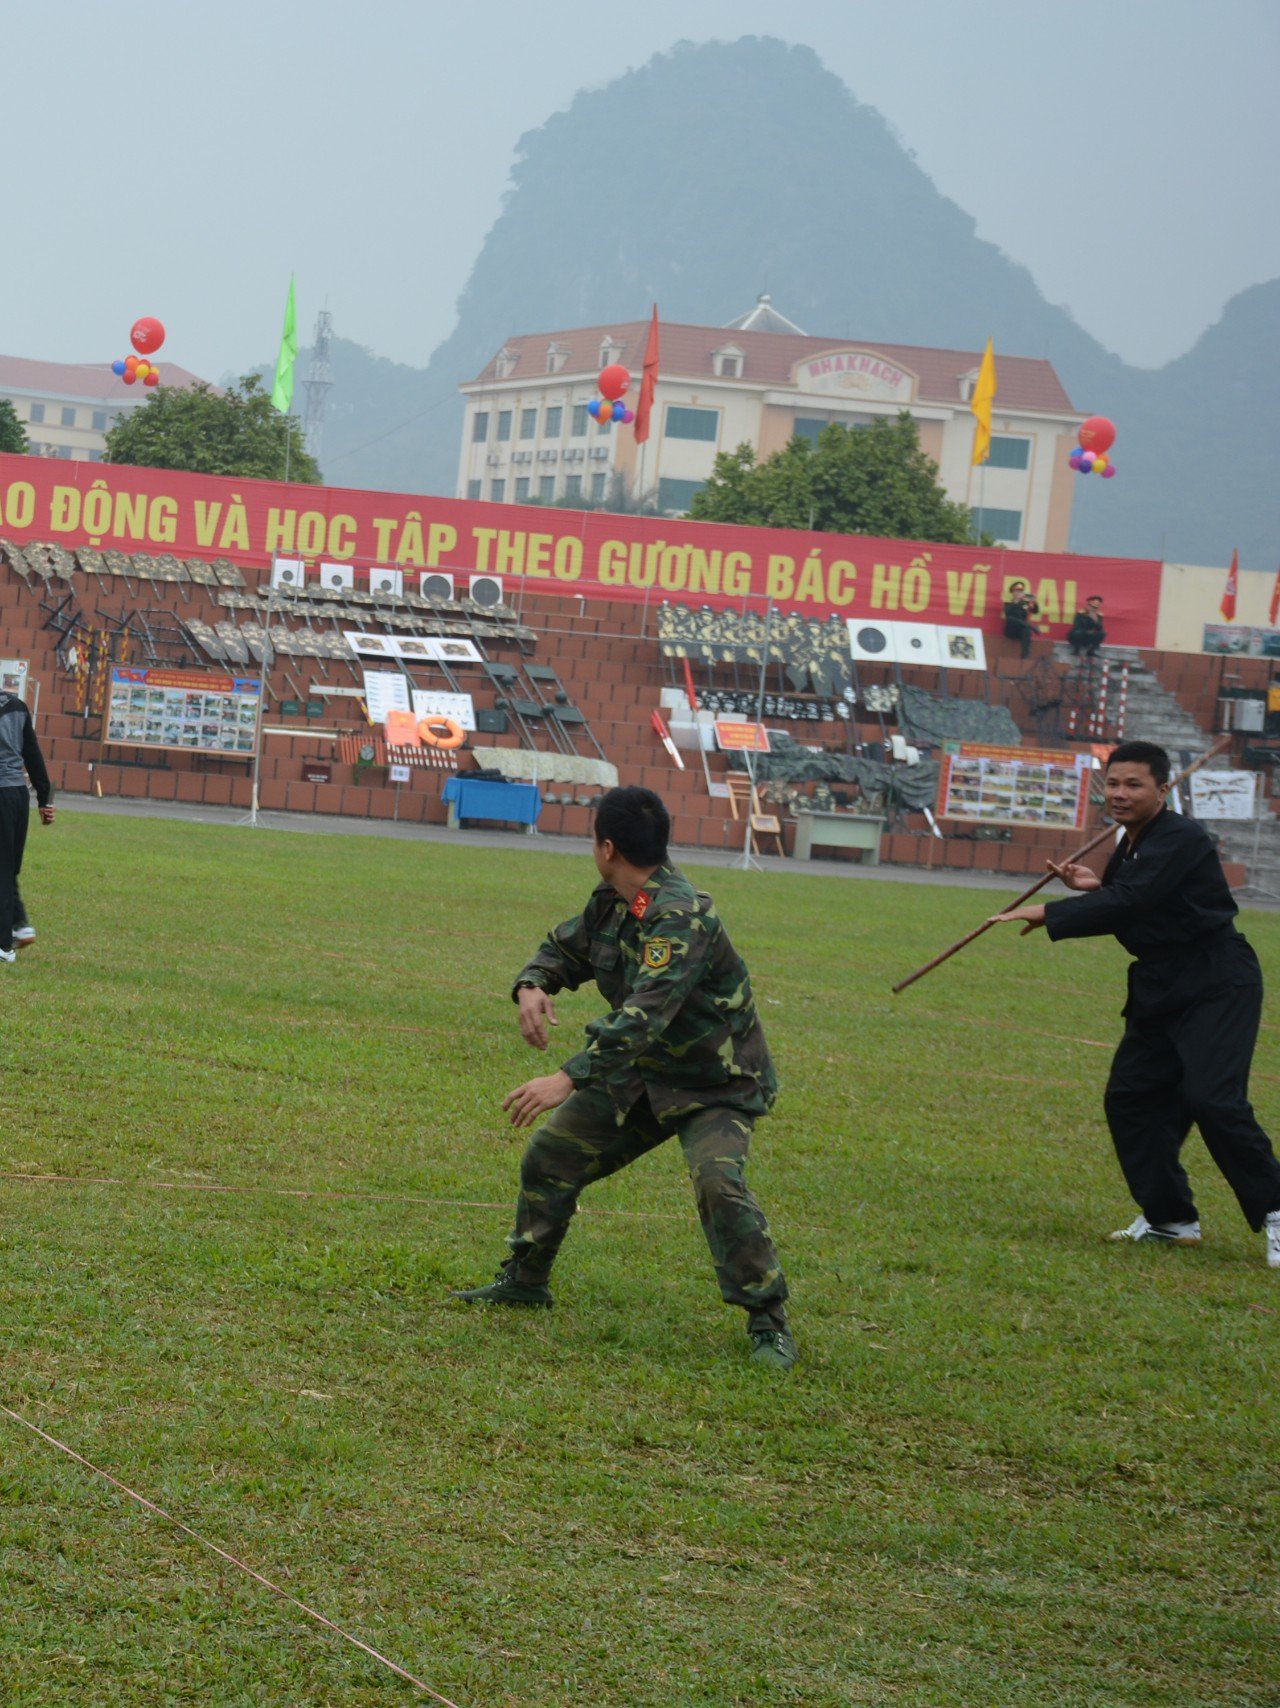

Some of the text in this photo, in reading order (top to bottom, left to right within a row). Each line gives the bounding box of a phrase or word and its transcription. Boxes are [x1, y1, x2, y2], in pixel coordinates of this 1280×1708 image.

[50, 480, 179, 545] ĐỘNG
[194, 494, 250, 551] VÀ
[265, 507, 358, 567] HỌC
[373, 511, 458, 576] TẬP
[472, 527, 584, 582] THEO
[598, 540, 752, 596] GƯƠNG
[766, 548, 857, 606] BÁC
[870, 553, 931, 612] HỒ
[946, 563, 992, 618] VĨ
